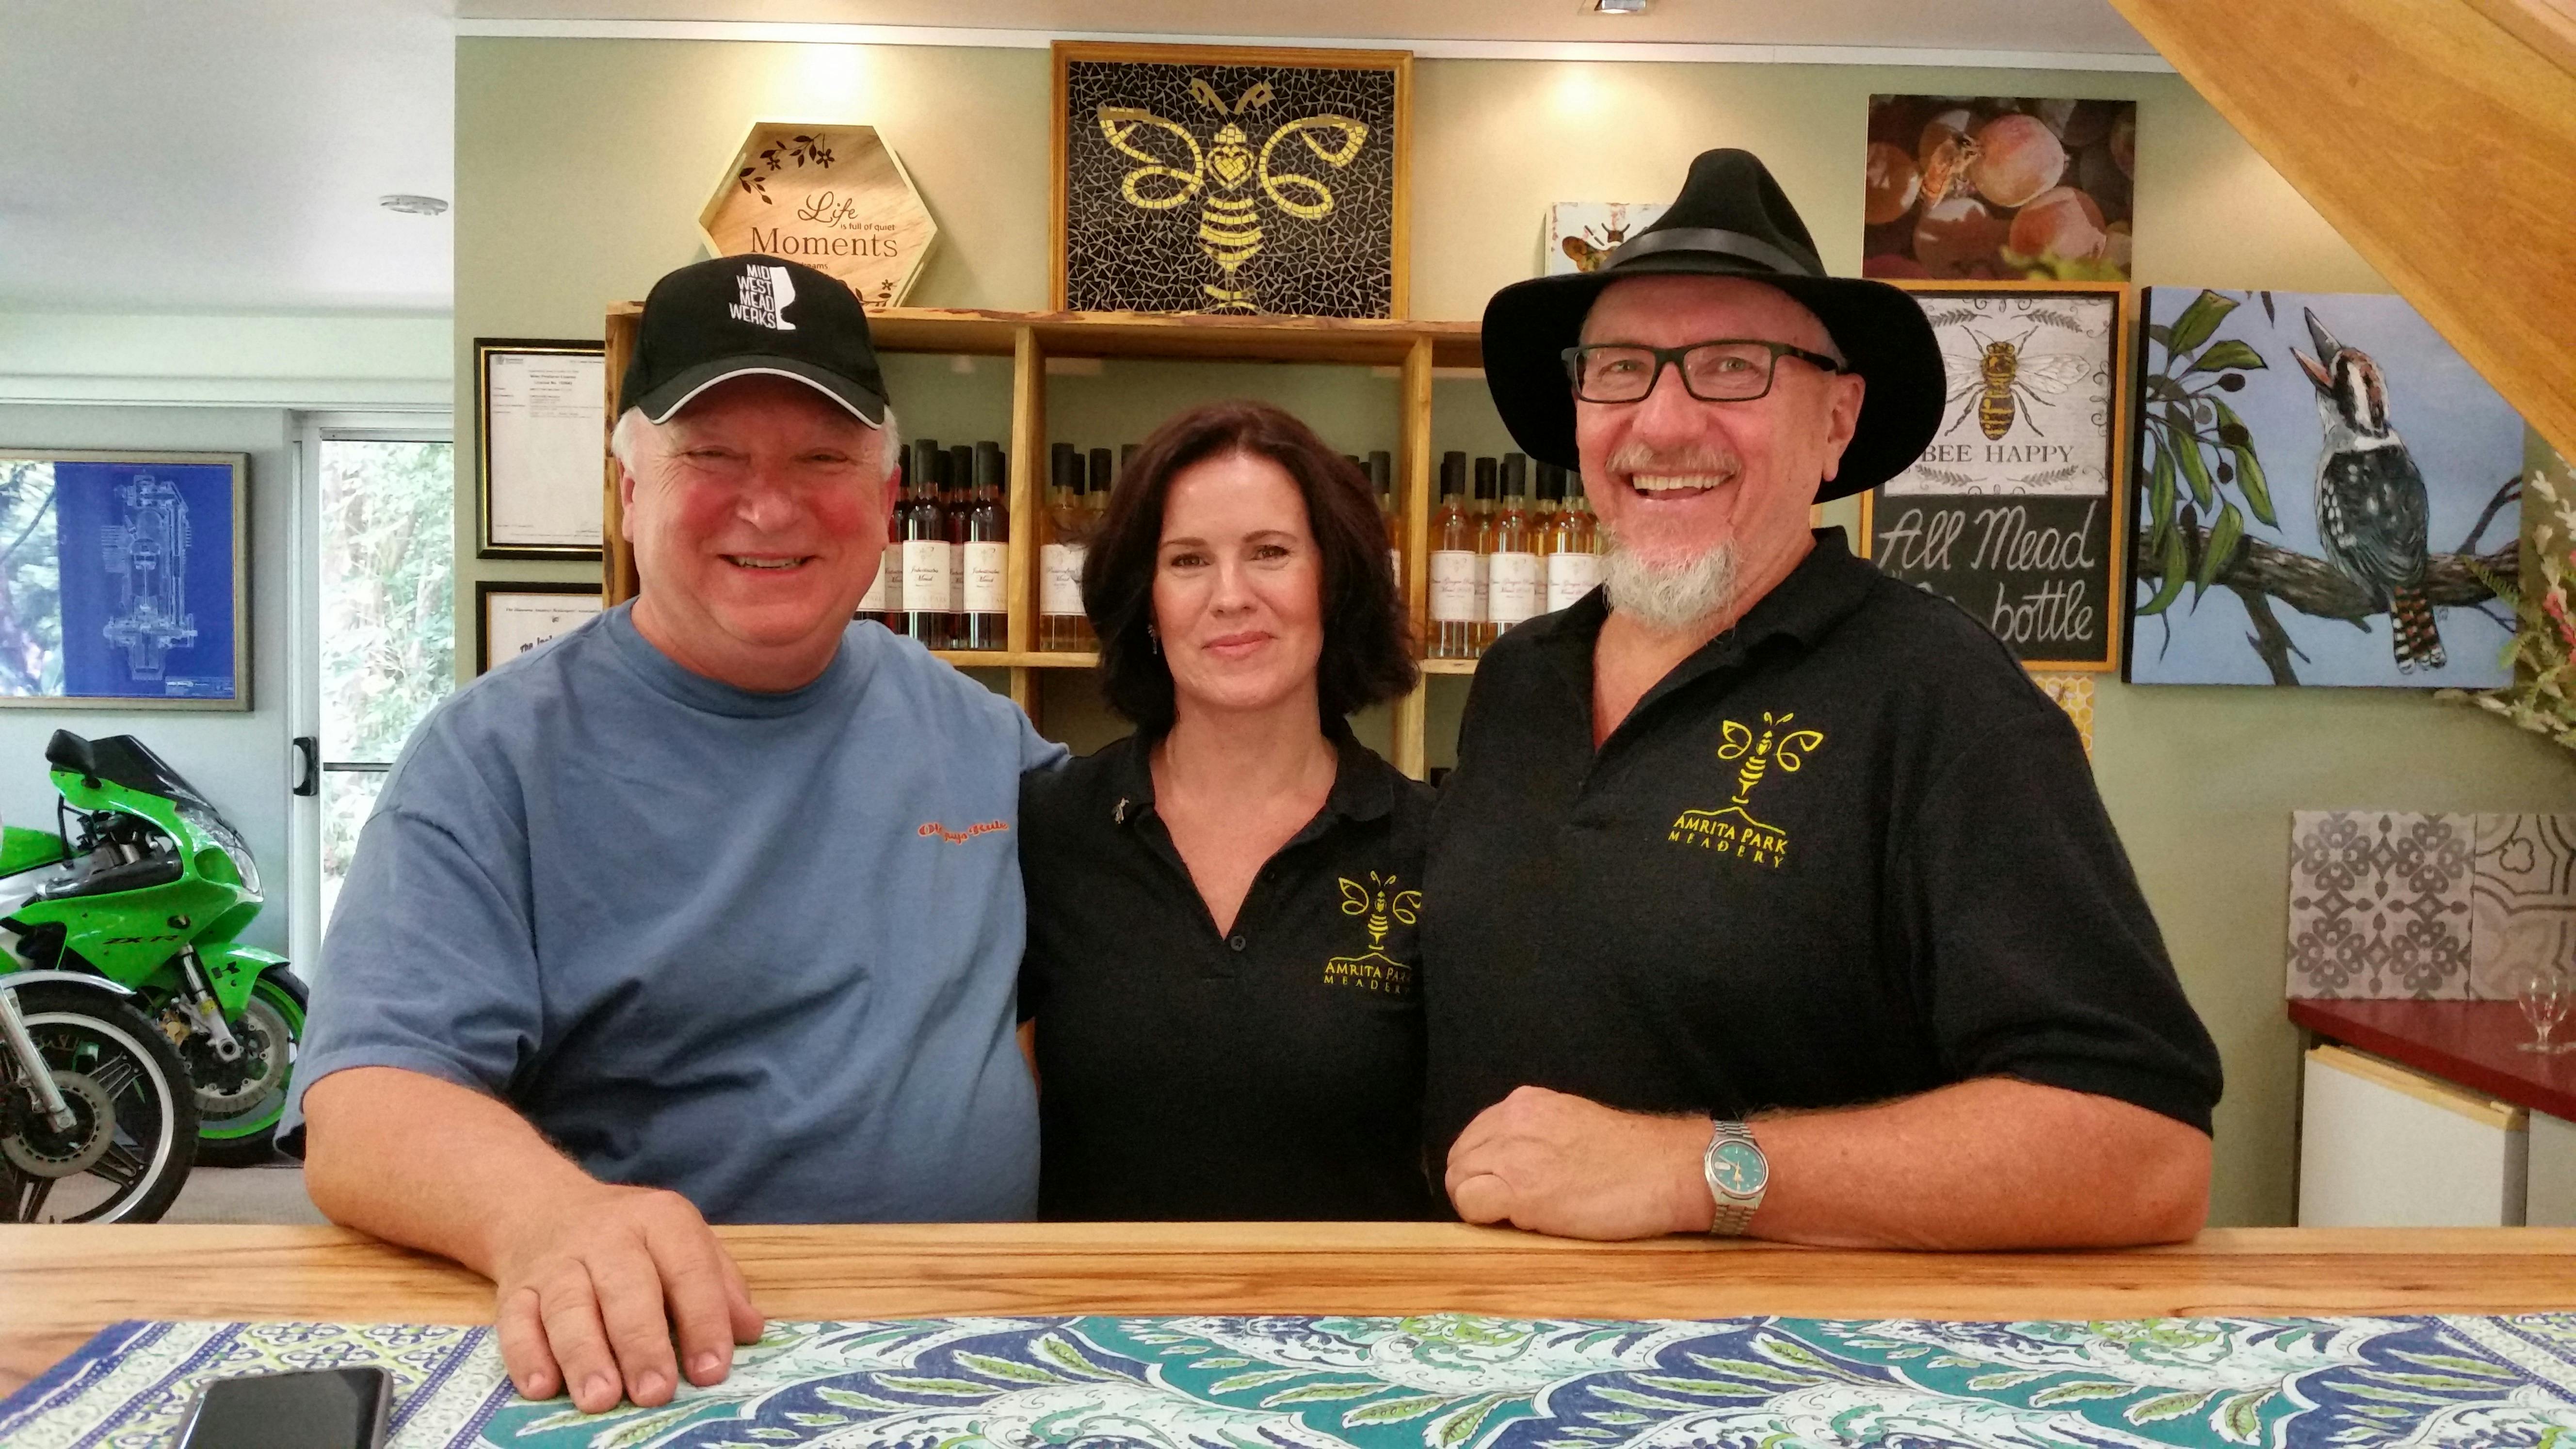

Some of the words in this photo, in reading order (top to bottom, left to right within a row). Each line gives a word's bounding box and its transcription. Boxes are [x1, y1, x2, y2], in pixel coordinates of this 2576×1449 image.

[798, 191, 858, 227] Life
[750, 226, 898, 258] Moments
[736, 274, 772, 296] WEST
[746, 264, 771, 280] MID
[729, 302, 776, 329] WERKS
[740, 290, 775, 312] MEAD
[1922, 444, 1972, 462] BEE
[1985, 444, 2074, 463] HAPPY
[1878, 508, 1966, 570] All
[1970, 499, 2098, 571] Mead
[1991, 579, 2093, 644] bottle
[1668, 831, 1784, 868] MEADERY
[1673, 815, 1735, 840] AMRITA
[1740, 828, 1789, 855] PARK
[1324, 961, 1382, 979] AMRITA
[1386, 967, 1411, 982] PAR
